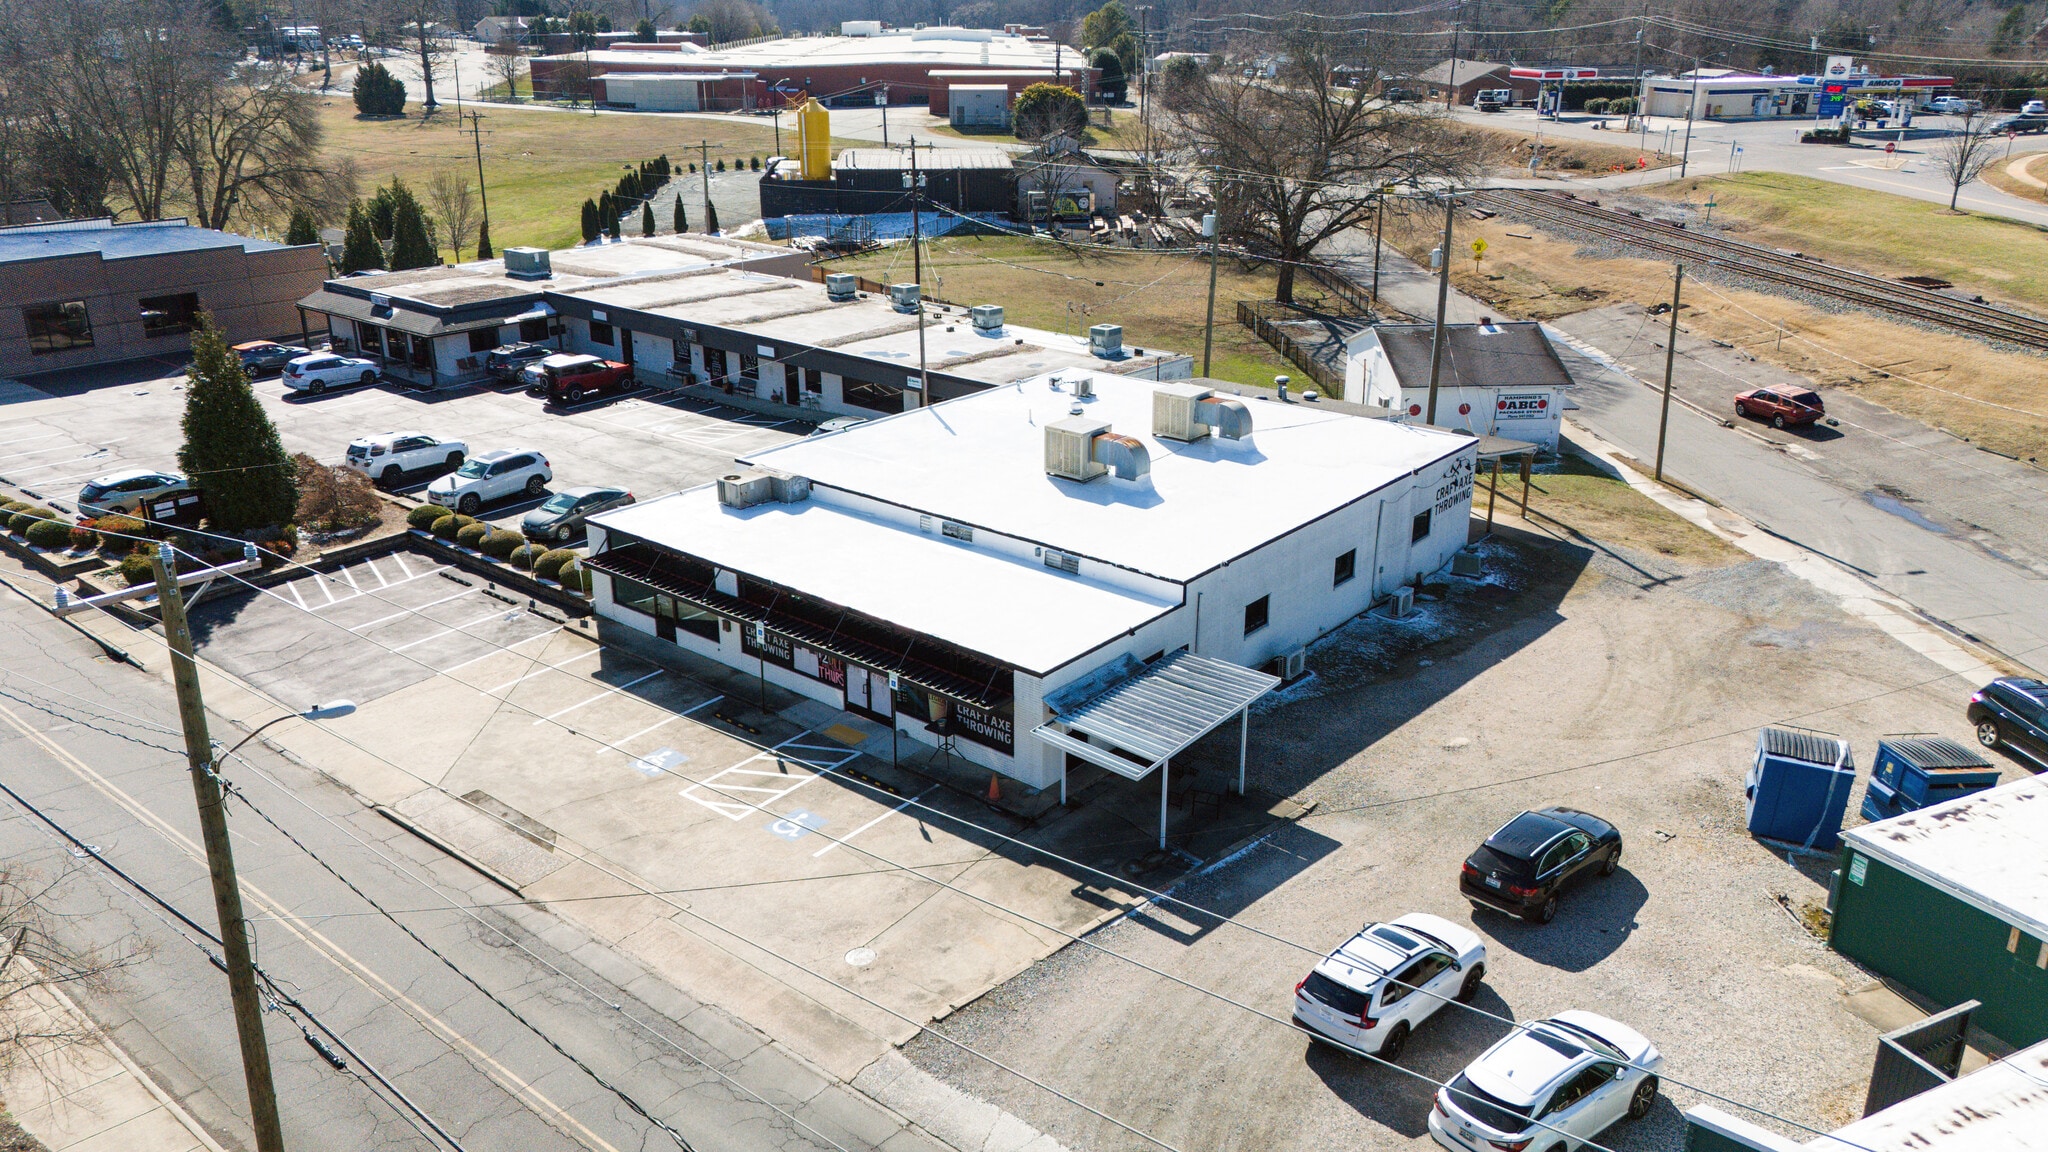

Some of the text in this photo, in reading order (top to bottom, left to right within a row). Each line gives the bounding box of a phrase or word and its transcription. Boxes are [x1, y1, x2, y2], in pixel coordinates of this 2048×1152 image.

[1507, 401, 1537, 410] ABC
[1436, 472, 1473, 501] CRAFT AXE
[1435, 487, 1471, 515] THROWING
[745, 625, 790, 649] CRT AXE
[818, 665, 845, 687] THURS
[956, 715, 1012, 744] THROWING
[957, 704, 1012, 732] CRAFT AXE
